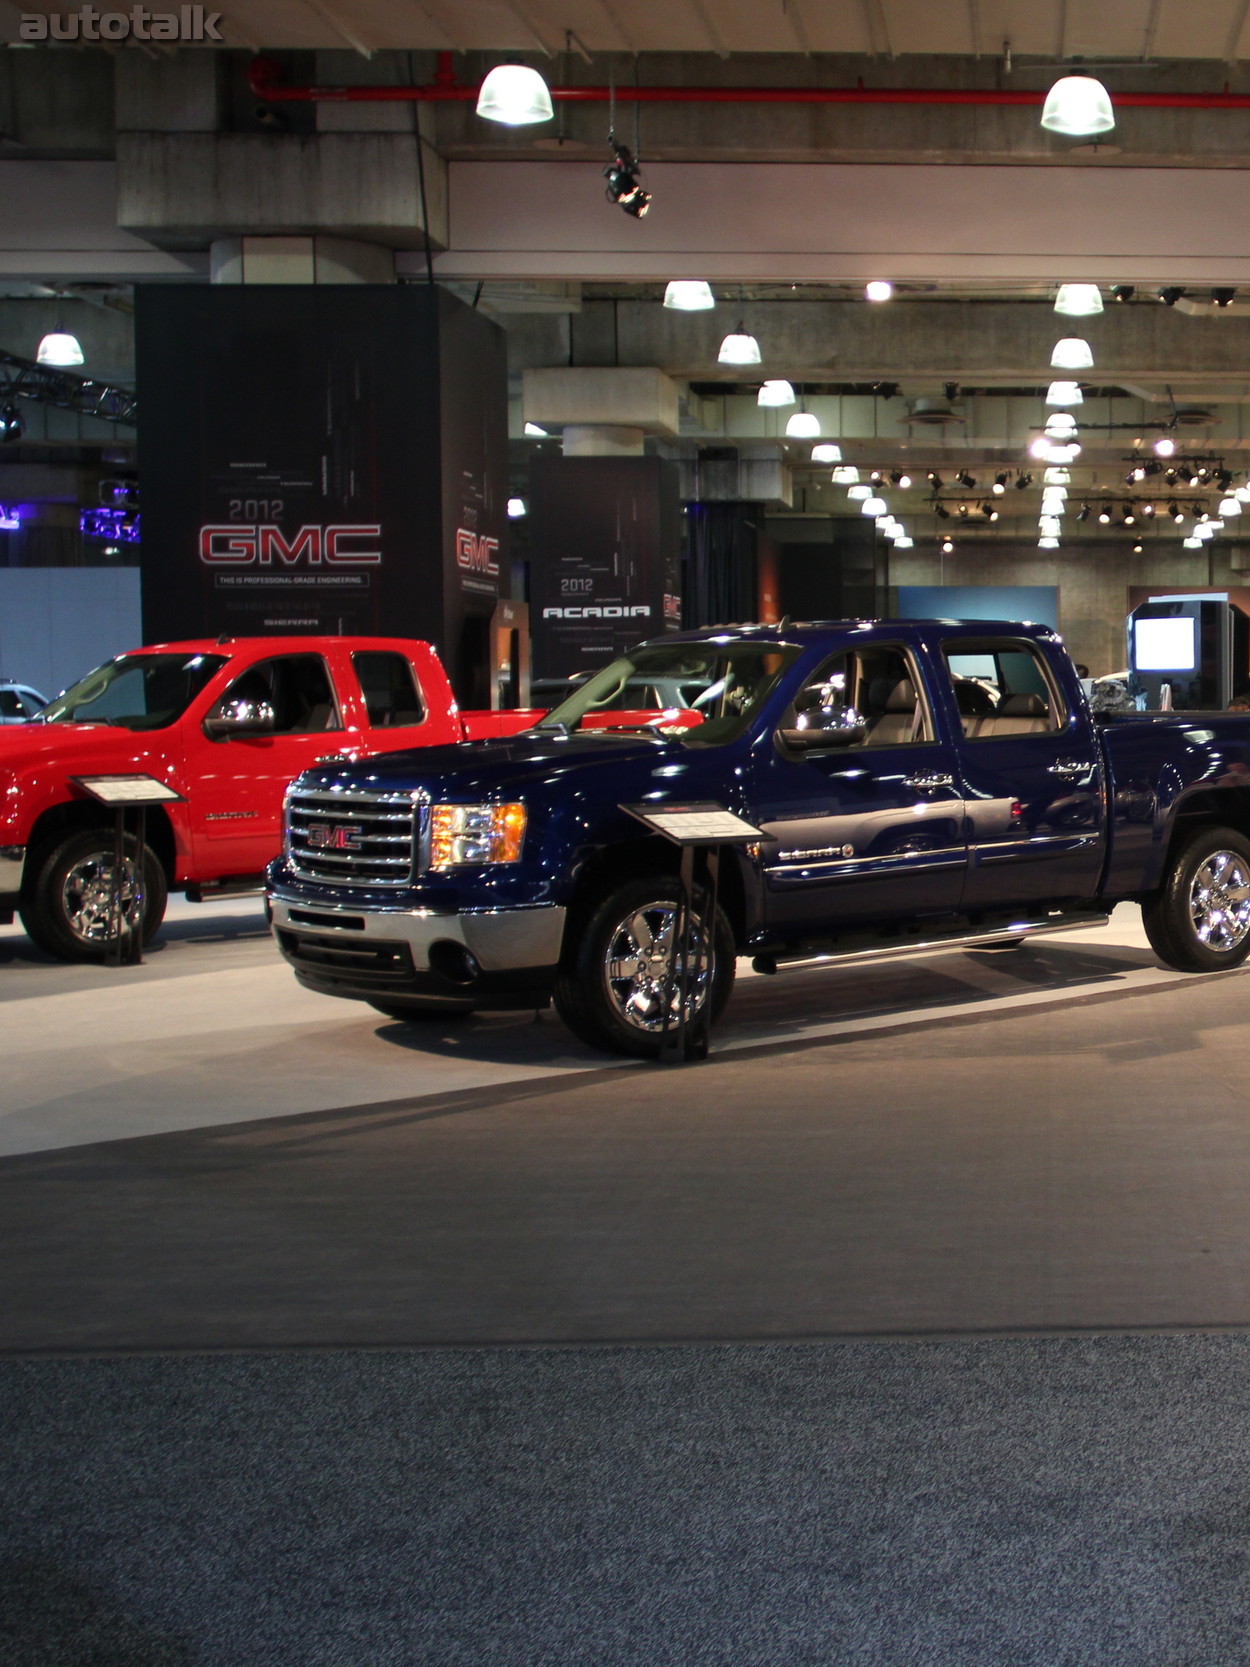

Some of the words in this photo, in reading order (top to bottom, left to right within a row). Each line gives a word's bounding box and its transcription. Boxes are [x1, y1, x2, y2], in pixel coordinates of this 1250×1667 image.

[229, 500, 284, 520] 2012
[200, 524, 382, 565] GMC
[456, 528, 499, 576] GMC
[219, 577, 234, 585] THIS
[236, 577, 243, 585] IS
[561, 578, 593, 591] 2012
[543, 605, 651, 619] ACADIA
[308, 823, 362, 850] GMC
